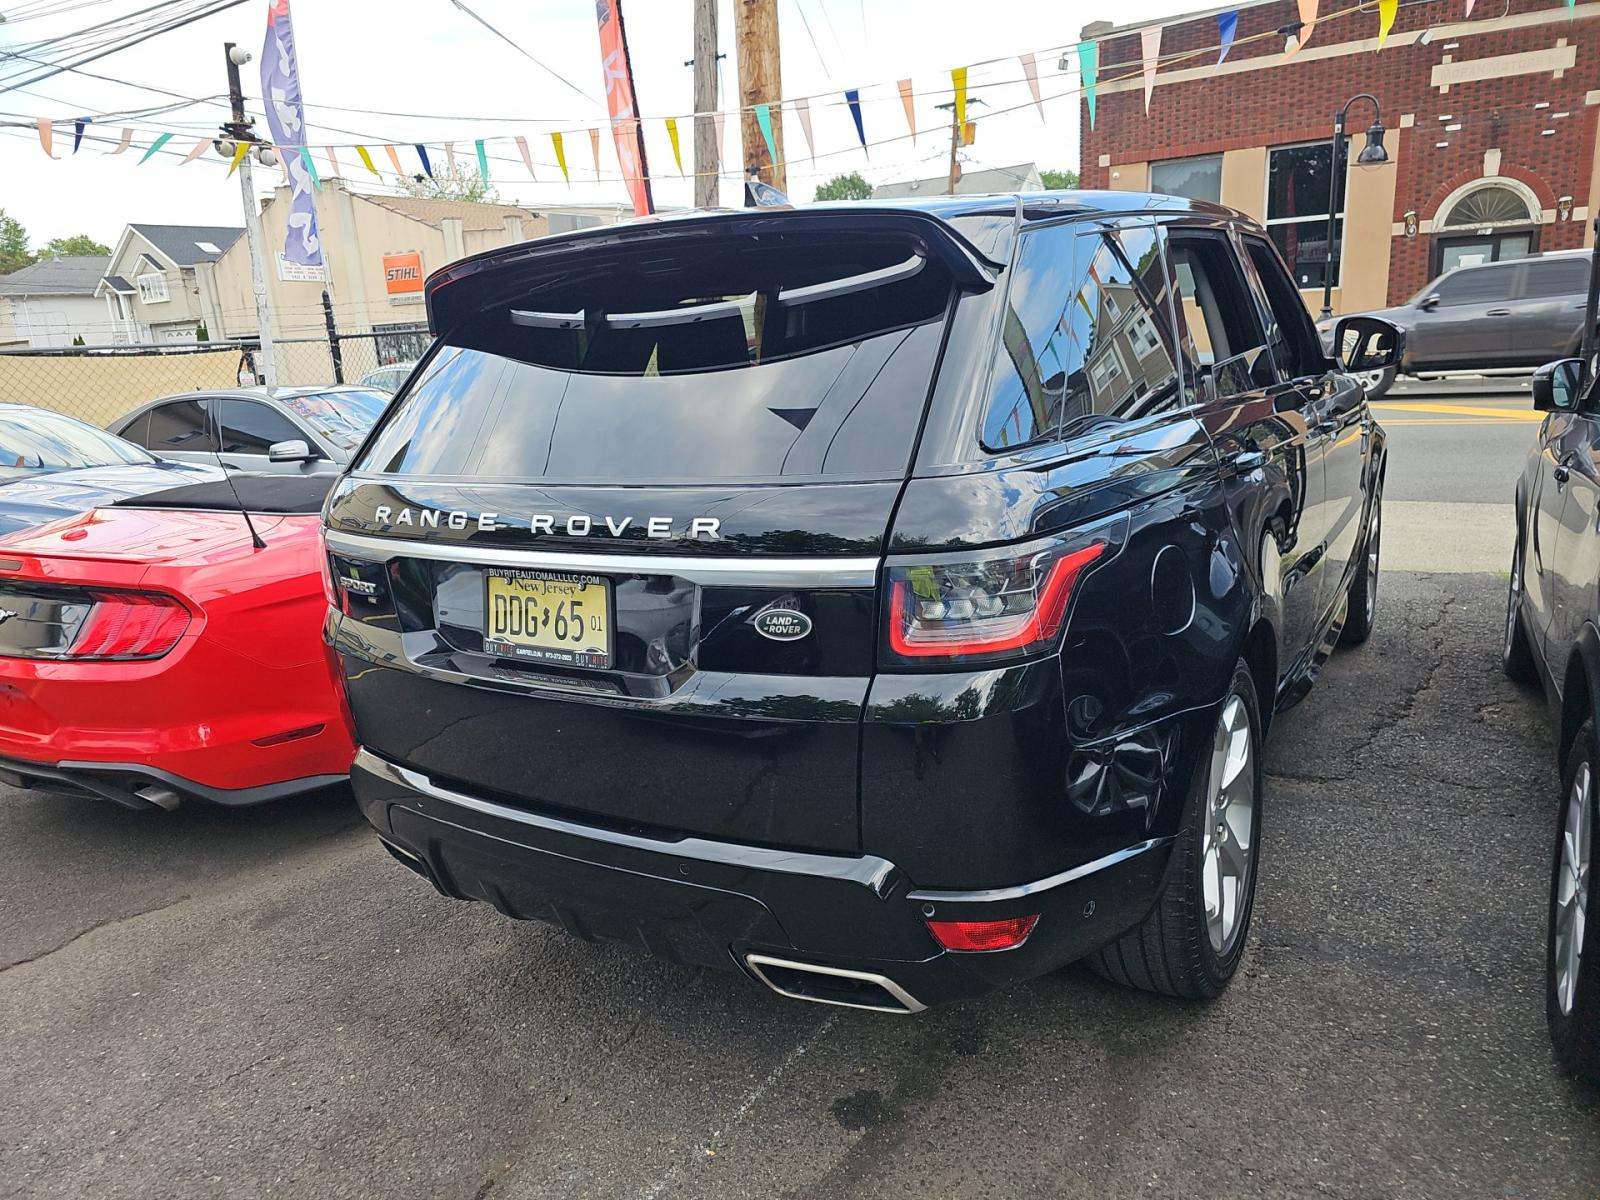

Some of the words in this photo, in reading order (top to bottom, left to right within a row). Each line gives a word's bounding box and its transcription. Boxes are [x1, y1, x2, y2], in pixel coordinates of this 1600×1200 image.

[387, 267, 419, 281] STIHL
[375, 506, 499, 532] RANGE
[530, 514, 722, 540] ROVER
[340, 577, 376, 593] SPORT
[514, 579, 540, 592] New
[541, 580, 577, 598] Jersey
[591, 615, 603, 632] 01
[485, 641, 497, 651] BUY
[575, 653, 589, 664] BUY
